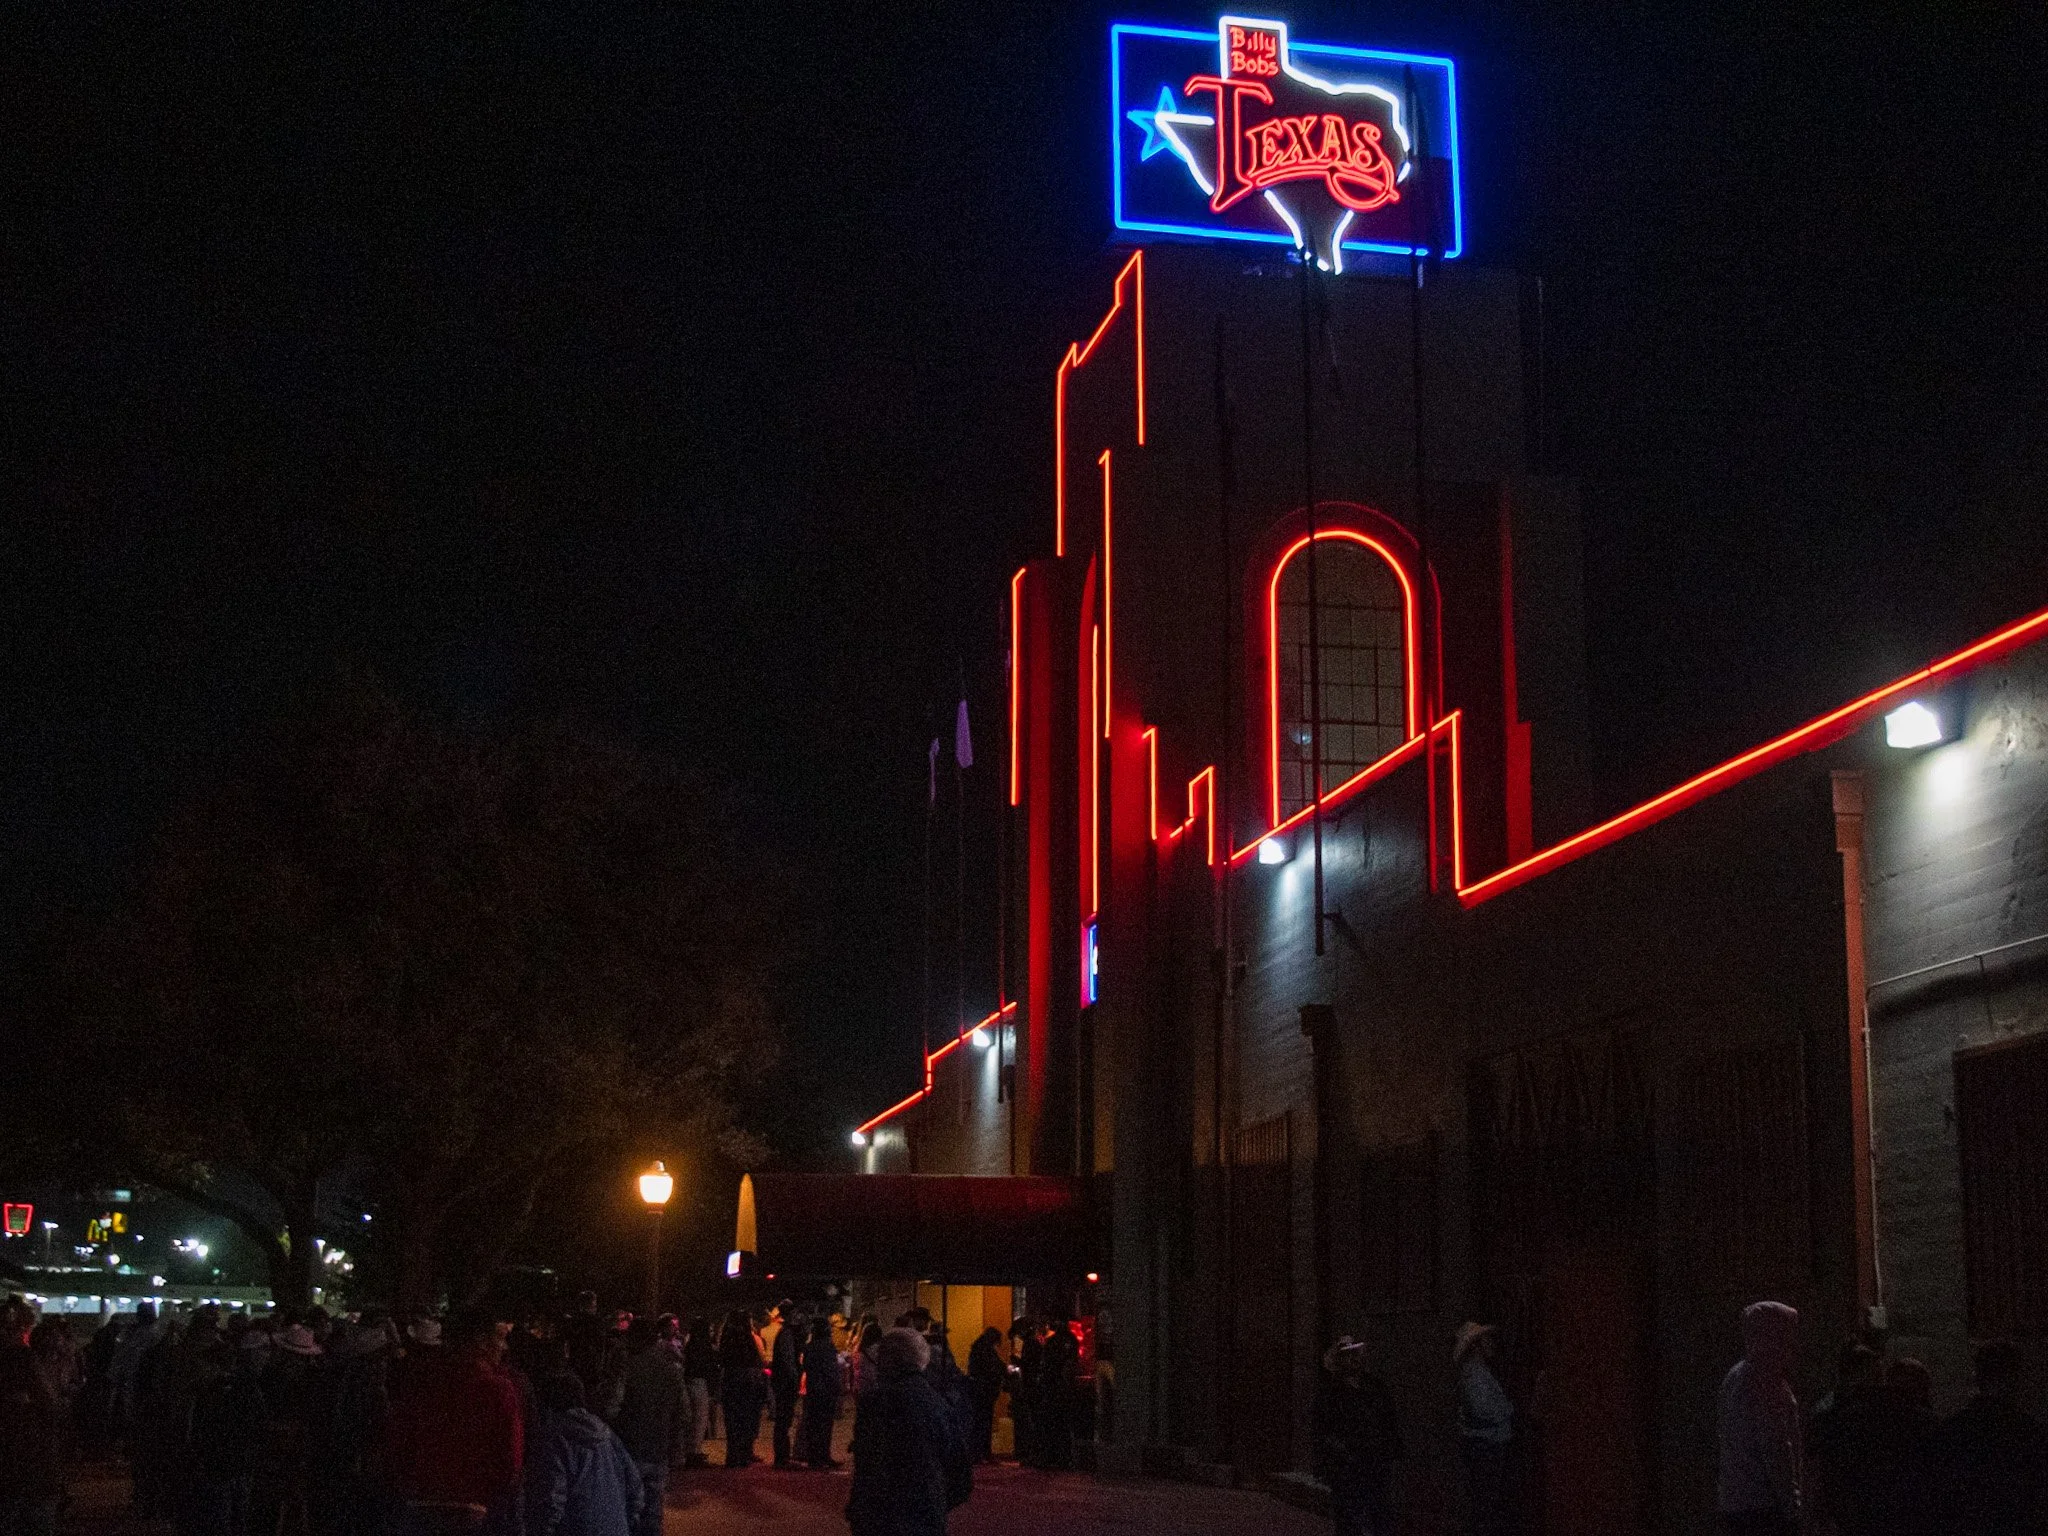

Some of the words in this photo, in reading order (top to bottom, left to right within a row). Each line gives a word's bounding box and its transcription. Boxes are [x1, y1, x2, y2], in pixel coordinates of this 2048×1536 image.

[1230, 27, 1277, 58] Billy
[1231, 50, 1279, 76] Bobs
[1185, 75, 1400, 212] TEXAS
